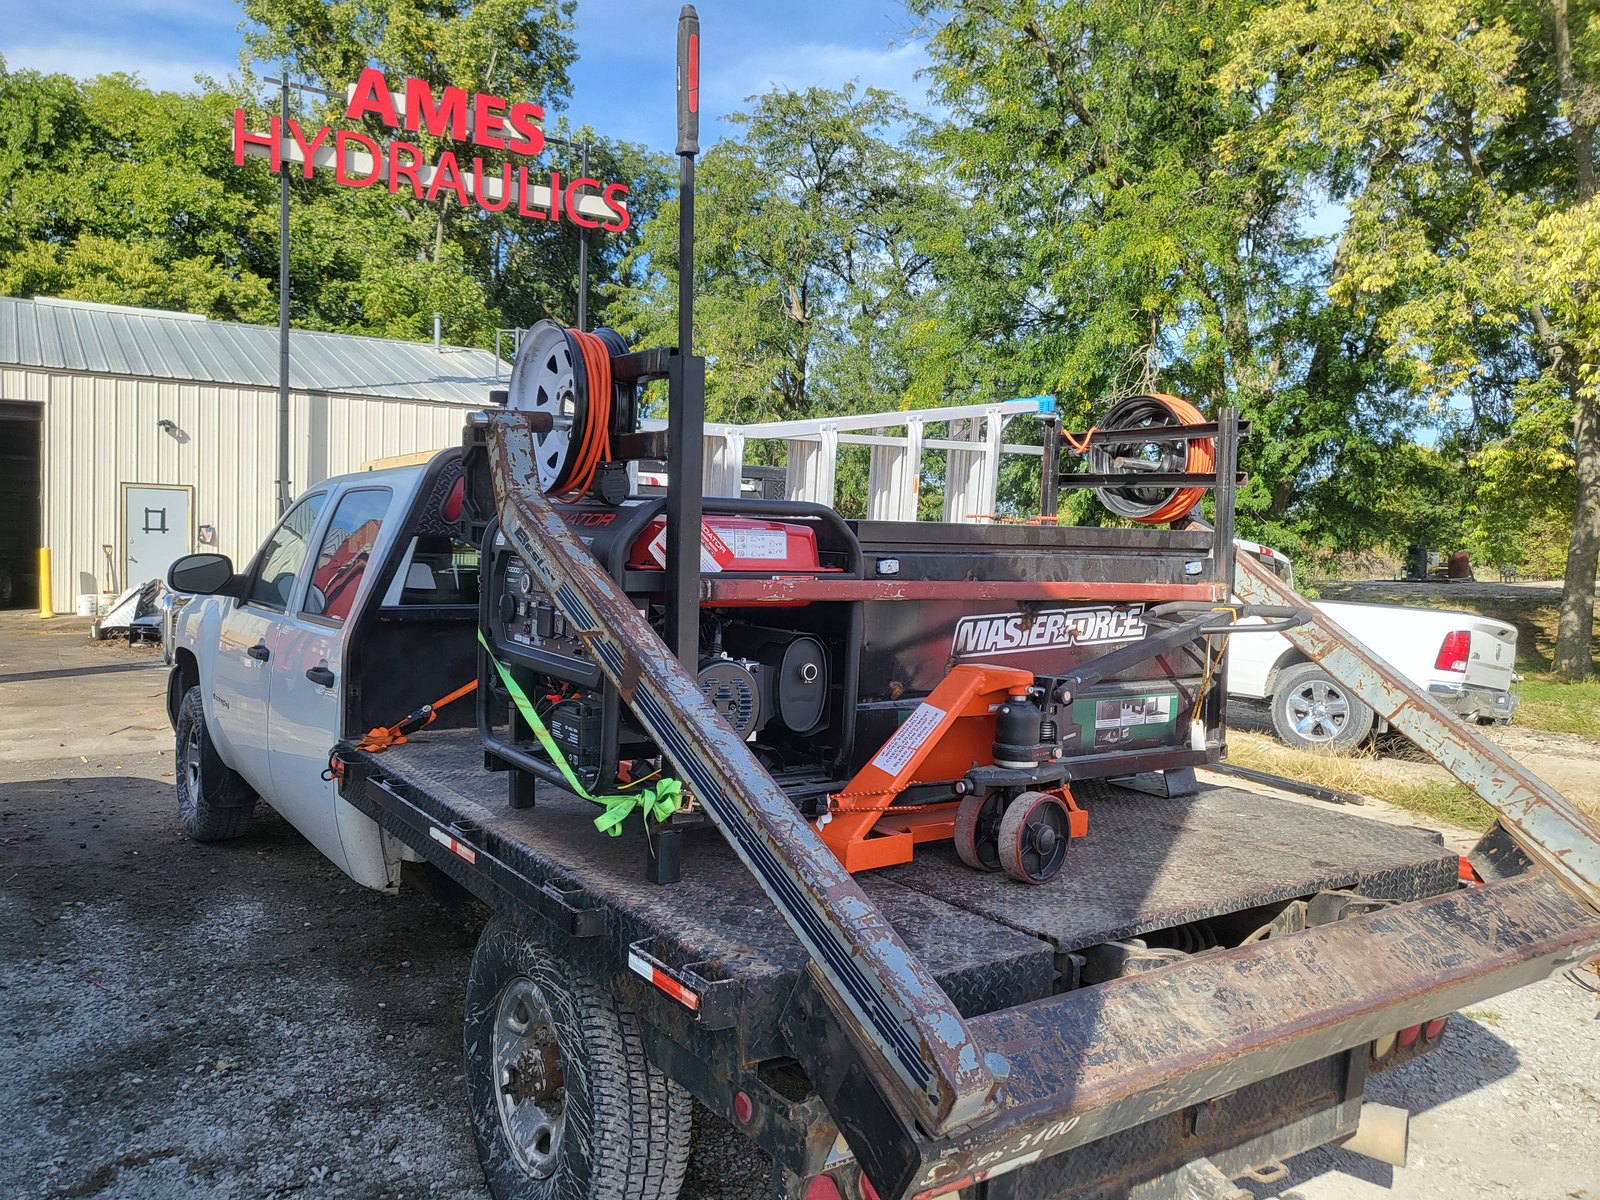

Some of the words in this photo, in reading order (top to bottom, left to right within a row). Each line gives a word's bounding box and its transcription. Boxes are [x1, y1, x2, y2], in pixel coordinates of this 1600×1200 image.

[345, 66, 545, 156] AMES
[232, 107, 631, 233] HYDRAULICS
[886, 745, 901, 763] CHECK
[902, 710, 929, 743] ADJUSTMENT
[886, 737, 897, 750] JACK
[893, 751, 907, 767] BLEED
[928, 712, 938, 725] JACK
[1011, 1115, 1081, 1153] 3100
